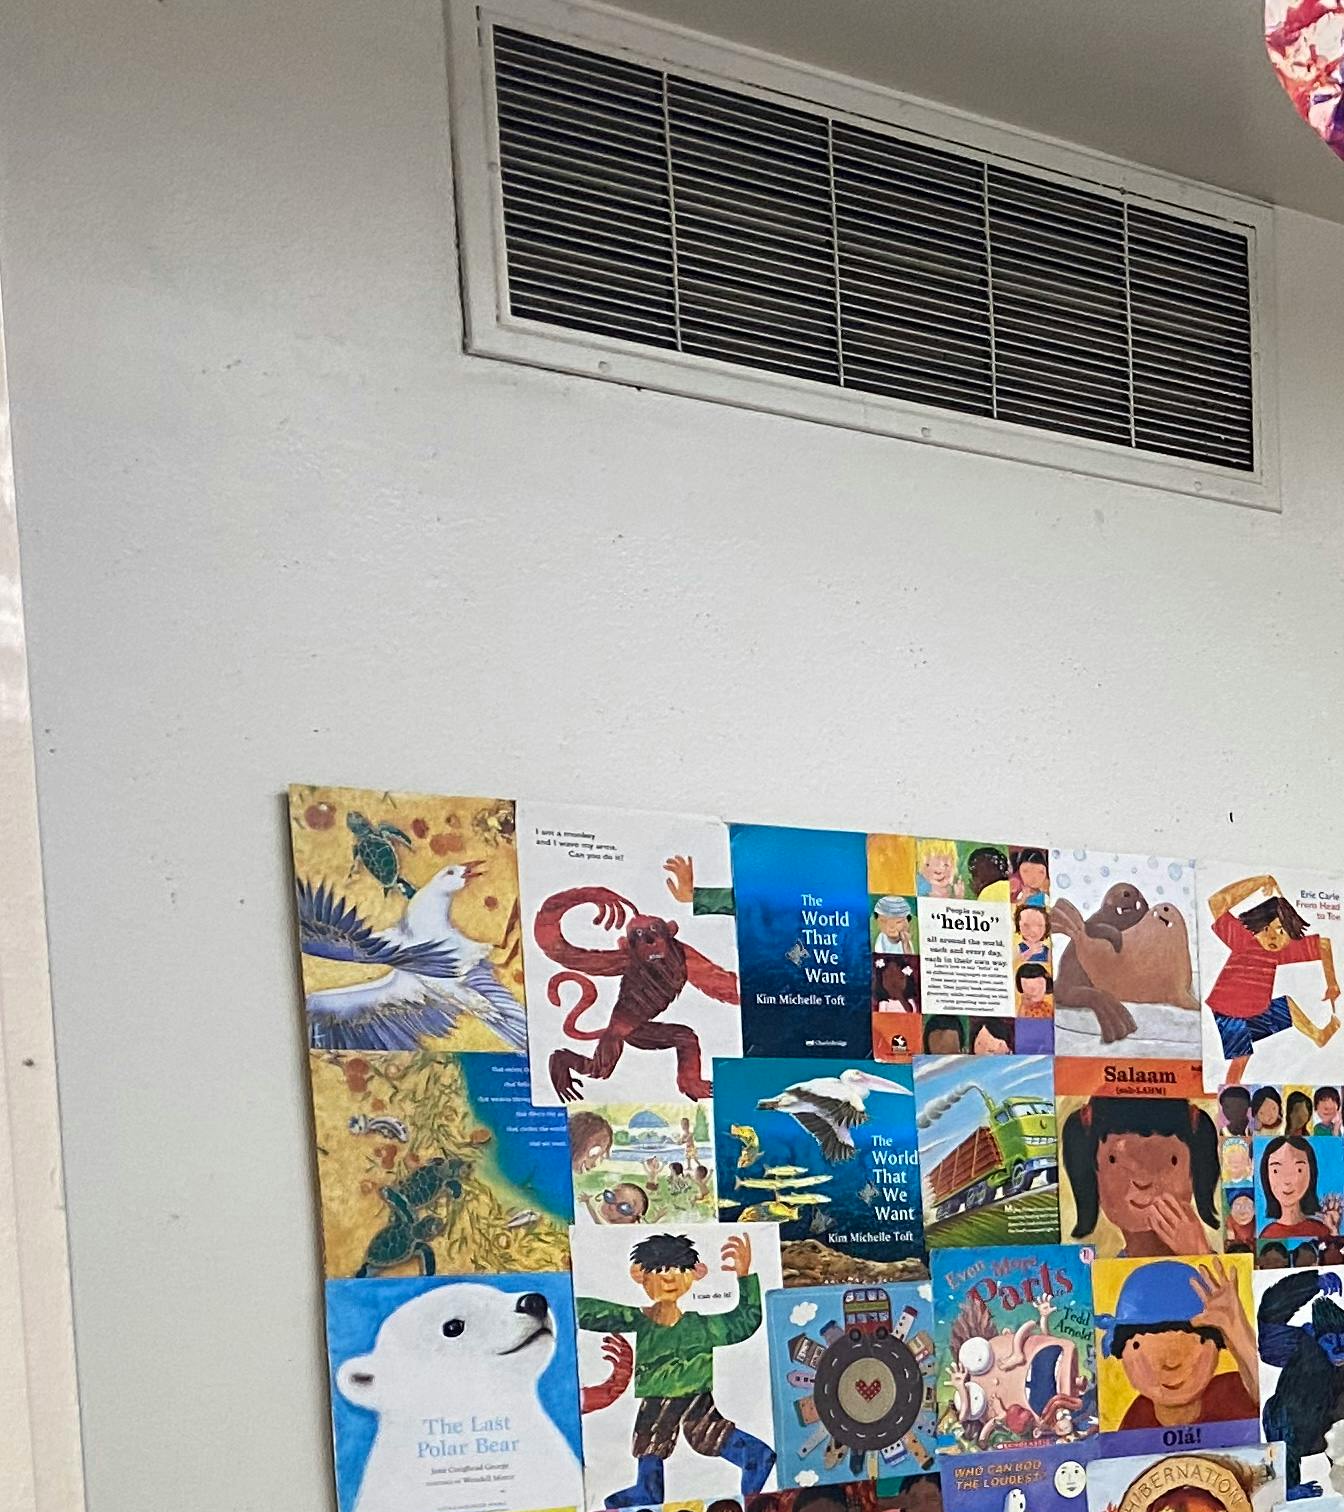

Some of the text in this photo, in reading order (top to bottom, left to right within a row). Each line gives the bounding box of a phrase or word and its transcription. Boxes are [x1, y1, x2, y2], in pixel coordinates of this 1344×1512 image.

[801, 894, 822, 907] The
[1301, 890, 1316, 899] Eric
[802, 911, 849, 927] World
[802, 929, 838, 946] That
[814, 949, 839, 965] We
[805, 968, 846, 984] Want
[756, 994, 846, 1006] Kim Michelle Toft
[1104, 1066, 1176, 1084] Salaam
[870, 1135, 893, 1147] The
[872, 1150, 919, 1166] World
[873, 1168, 907, 1184] That
[882, 1187, 908, 1203] We
[875, 1206, 915, 1221] Want
[828, 1231, 914, 1243] Kim Michelle Toft
[945, 1256, 1037, 1290] Even More
[1063, 1306, 1091, 1326] Tedd
[1054, 1320, 1092, 1341] Arnold
[422, 1416, 513, 1435] The Last
[1162, 1429, 1202, 1446] Olá!
[417, 1438, 520, 1458] Polar Bear
[954, 1460, 1042, 1478] WHO CAN BOO
[956, 1479, 980, 1490] THE
